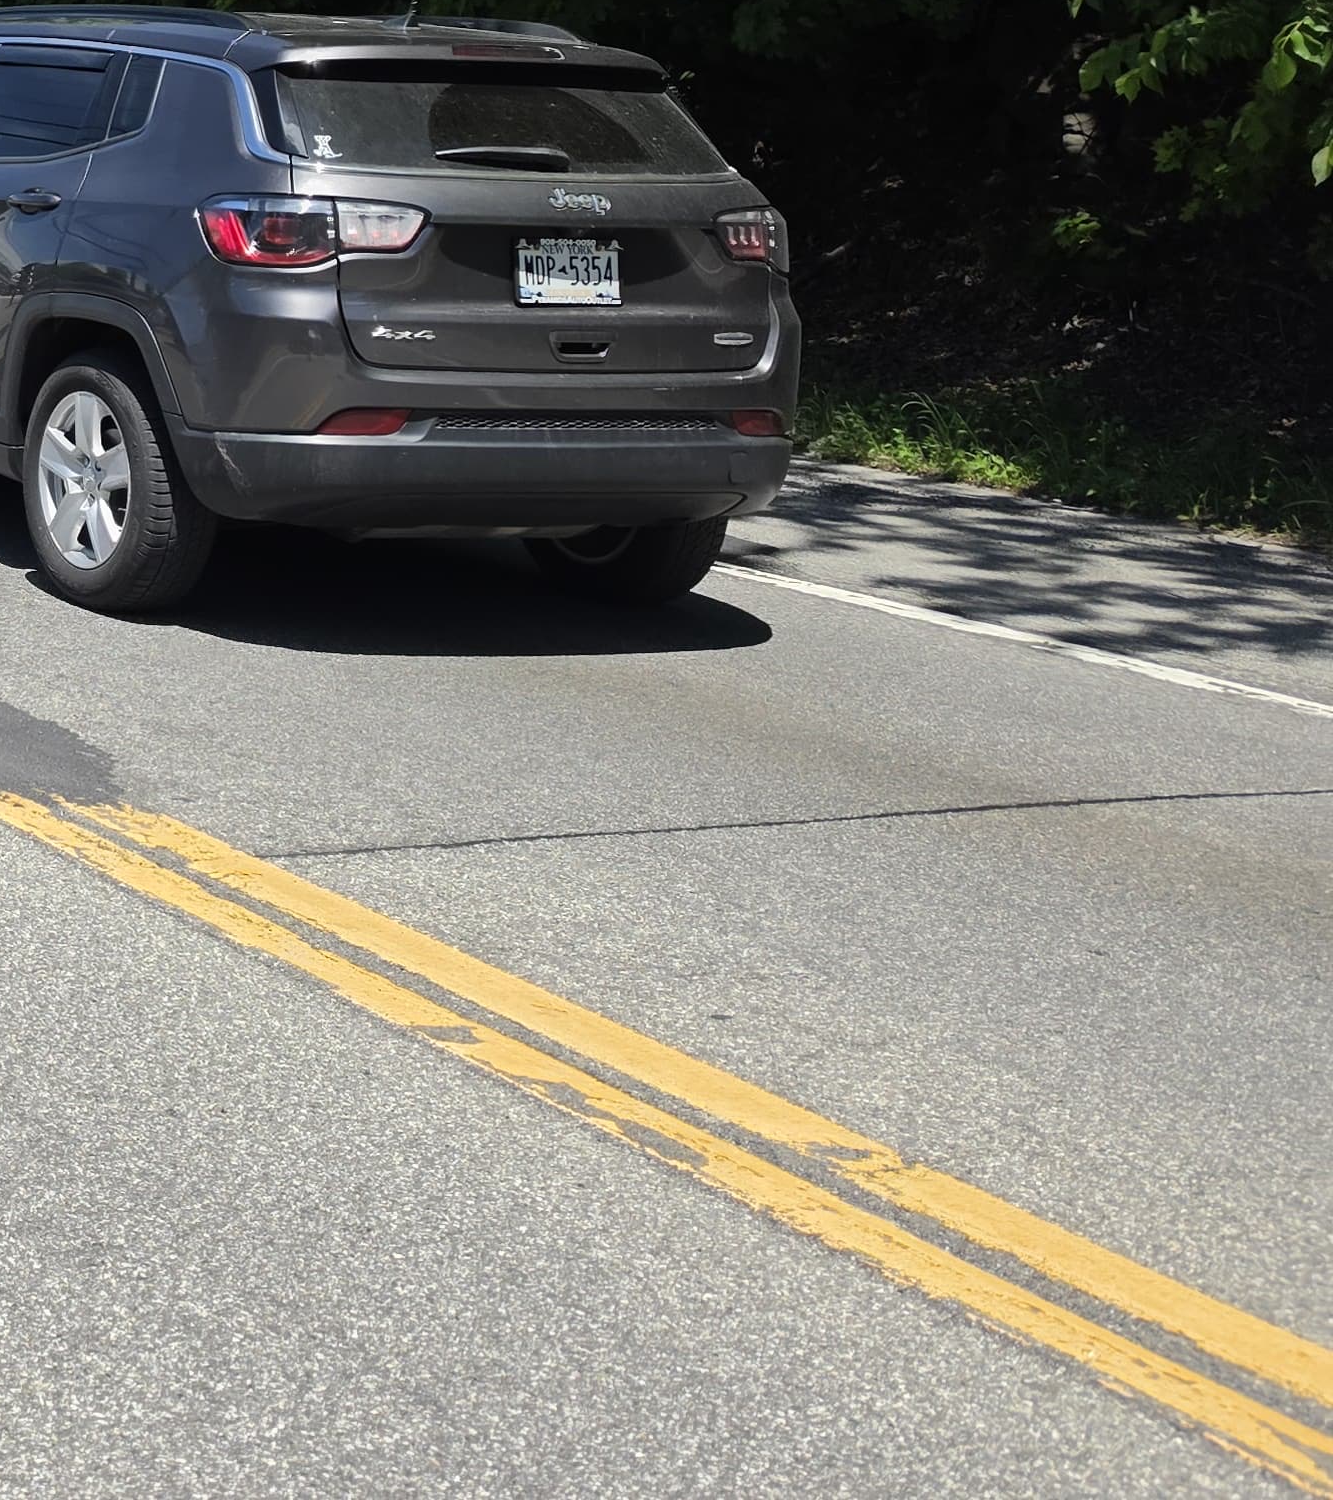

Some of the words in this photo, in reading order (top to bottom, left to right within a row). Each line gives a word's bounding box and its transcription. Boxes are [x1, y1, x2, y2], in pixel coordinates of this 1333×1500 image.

[549, 188, 611, 215] Jeep
[542, 244, 564, 255] NEW
[565, 244, 595, 256] YORK
[371, 325, 436, 340] 4x4
